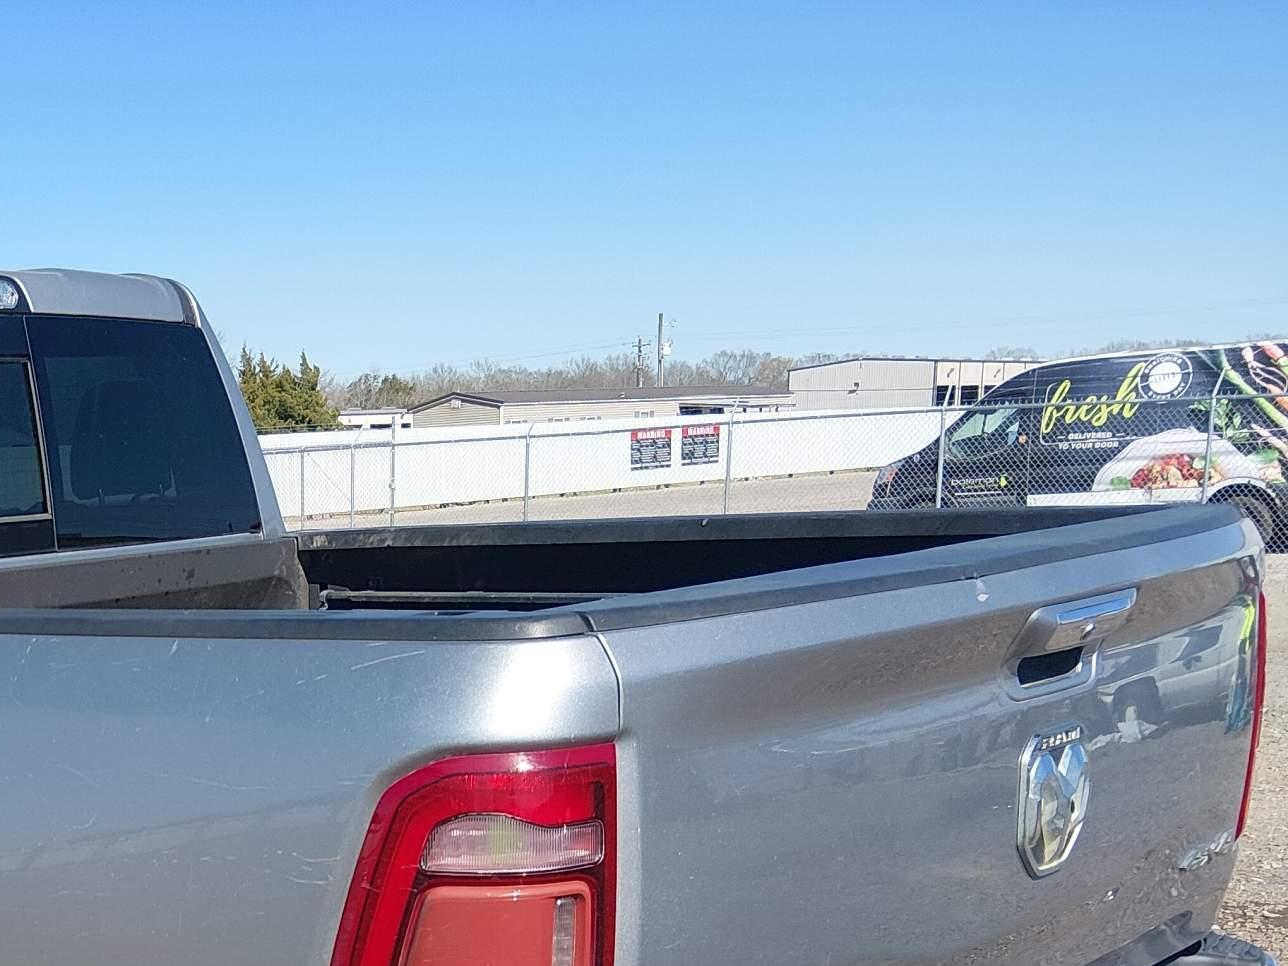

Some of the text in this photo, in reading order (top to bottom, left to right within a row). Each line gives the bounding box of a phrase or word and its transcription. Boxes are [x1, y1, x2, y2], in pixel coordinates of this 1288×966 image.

[1042, 361, 1144, 433] fresh
[637, 430, 665, 439] WARNING
[1067, 432, 1113, 440] DELIVERED
[1094, 441, 1119, 449] DOOR
[1041, 727, 1081, 749] RAM
